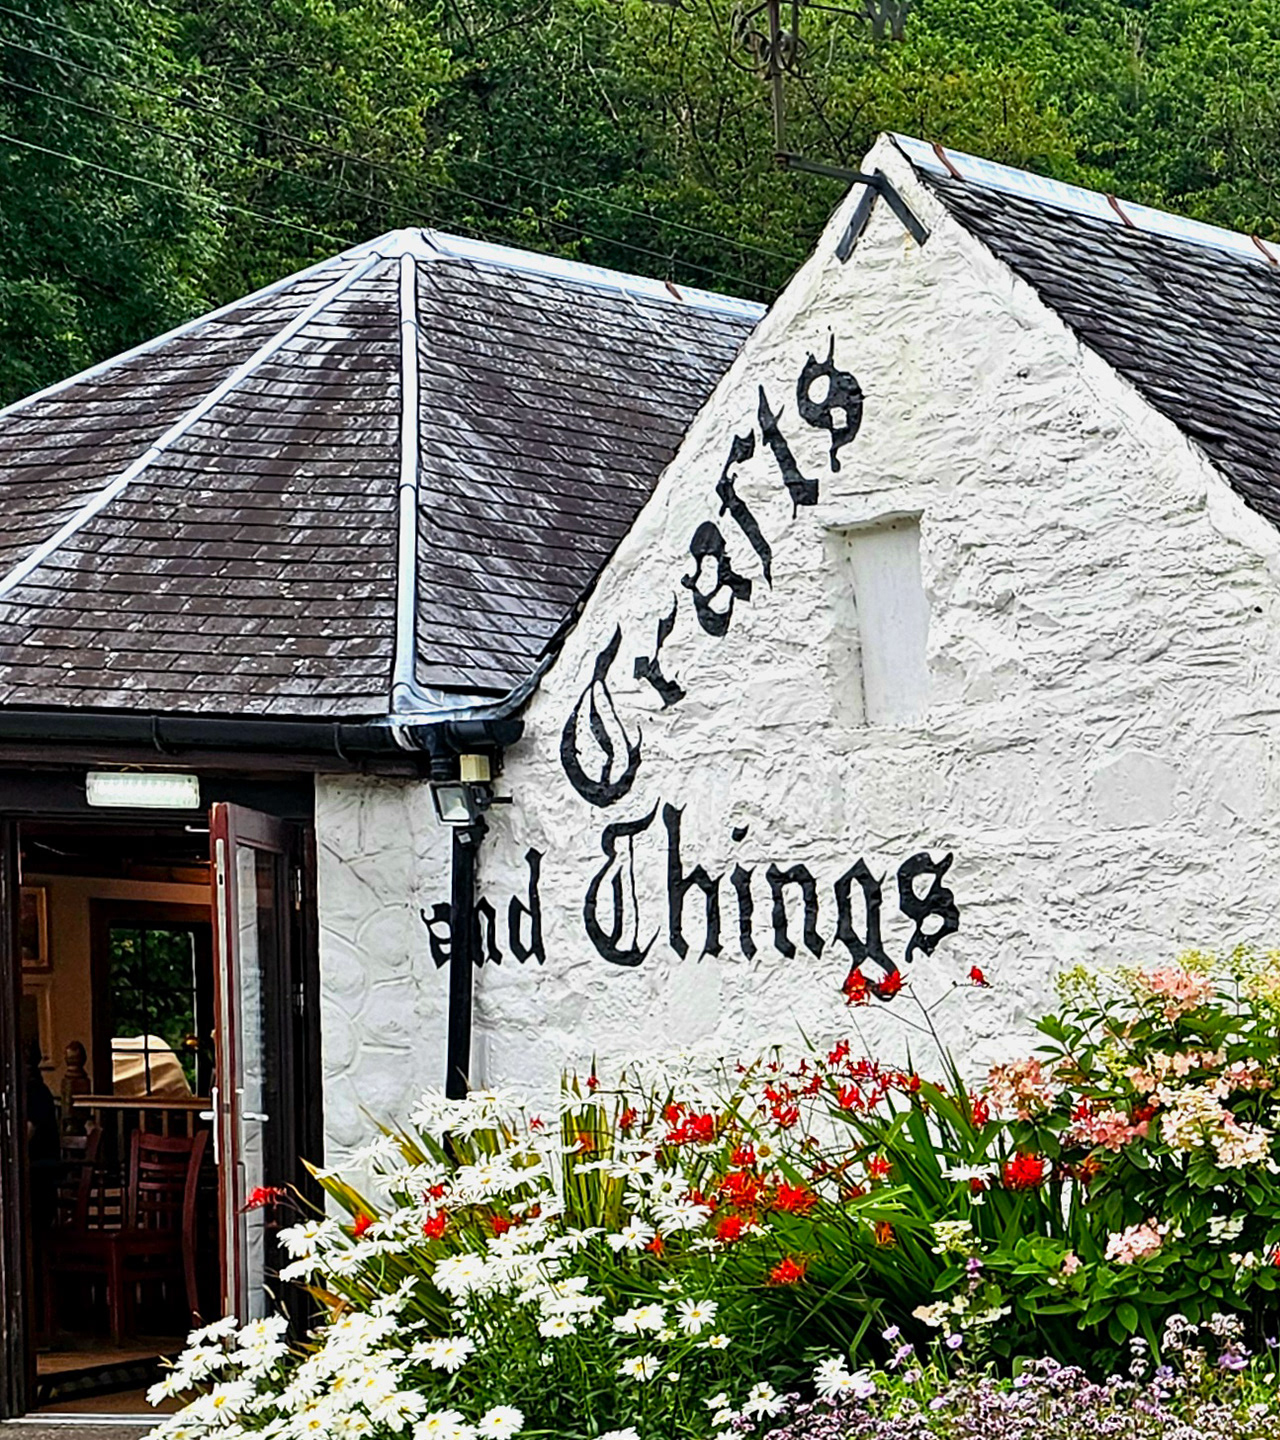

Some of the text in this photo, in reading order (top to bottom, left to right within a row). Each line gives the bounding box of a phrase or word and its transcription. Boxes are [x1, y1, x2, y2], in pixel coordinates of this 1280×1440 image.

[561, 327, 865, 808] Crafts
[420, 798, 961, 1001] and Things
